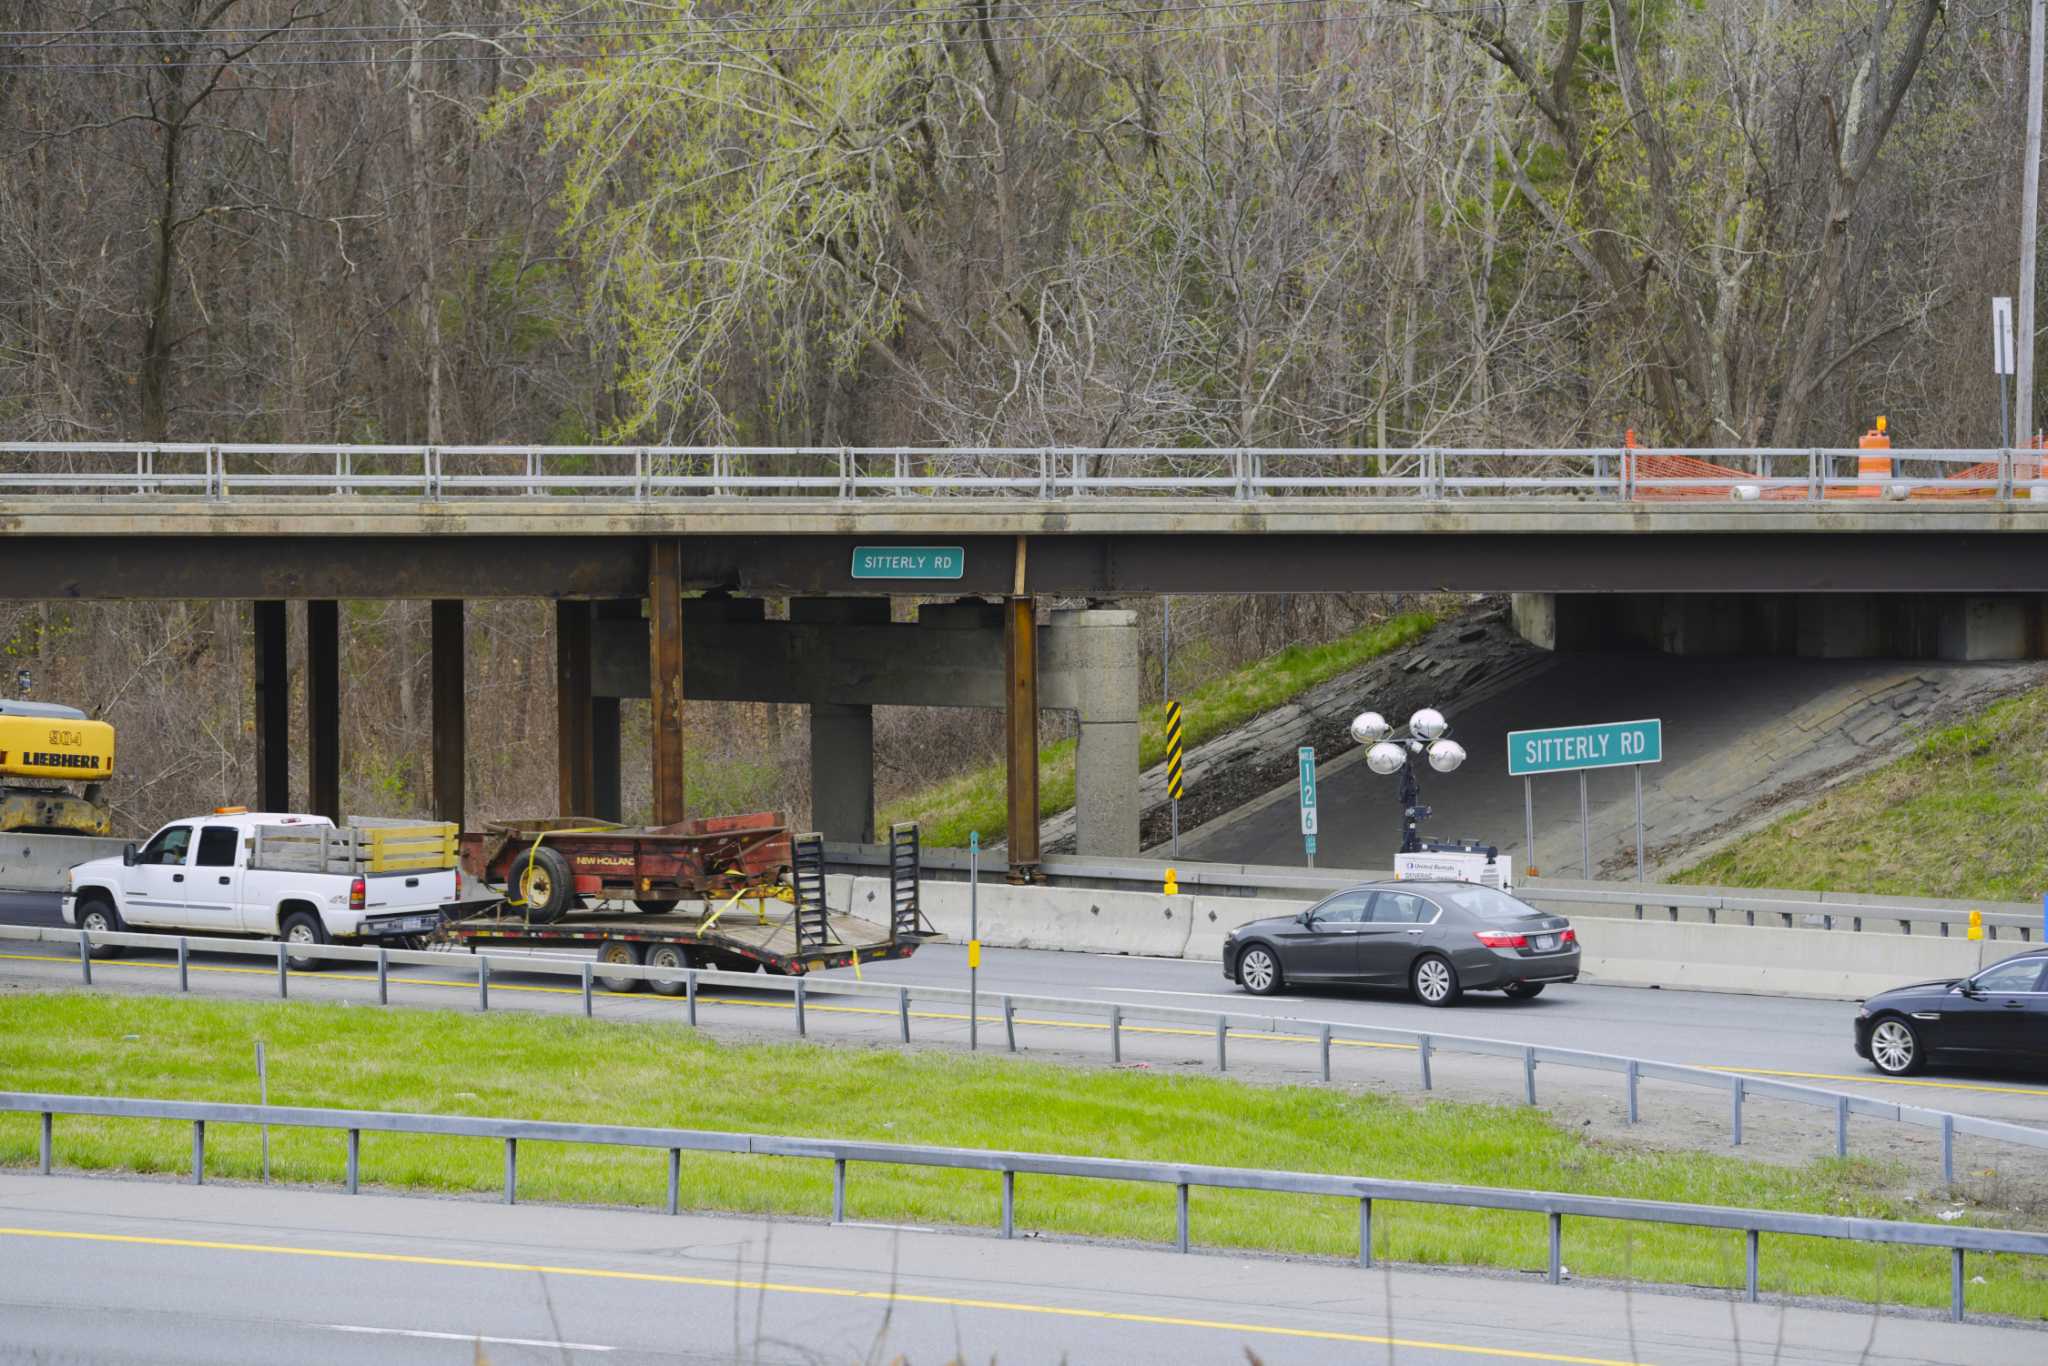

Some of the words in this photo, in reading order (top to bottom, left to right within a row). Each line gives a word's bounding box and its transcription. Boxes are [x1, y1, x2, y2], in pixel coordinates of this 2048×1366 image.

[864, 556, 926, 569] SITTERLY
[934, 556, 952, 569] RD
[1526, 734, 1609, 763] SITTERLY
[1621, 731, 1645, 755] RD
[23, 751, 100, 769] LIEBHERR
[576, 856, 596, 865] NEW
[597, 856, 636, 866] HOLLAND
